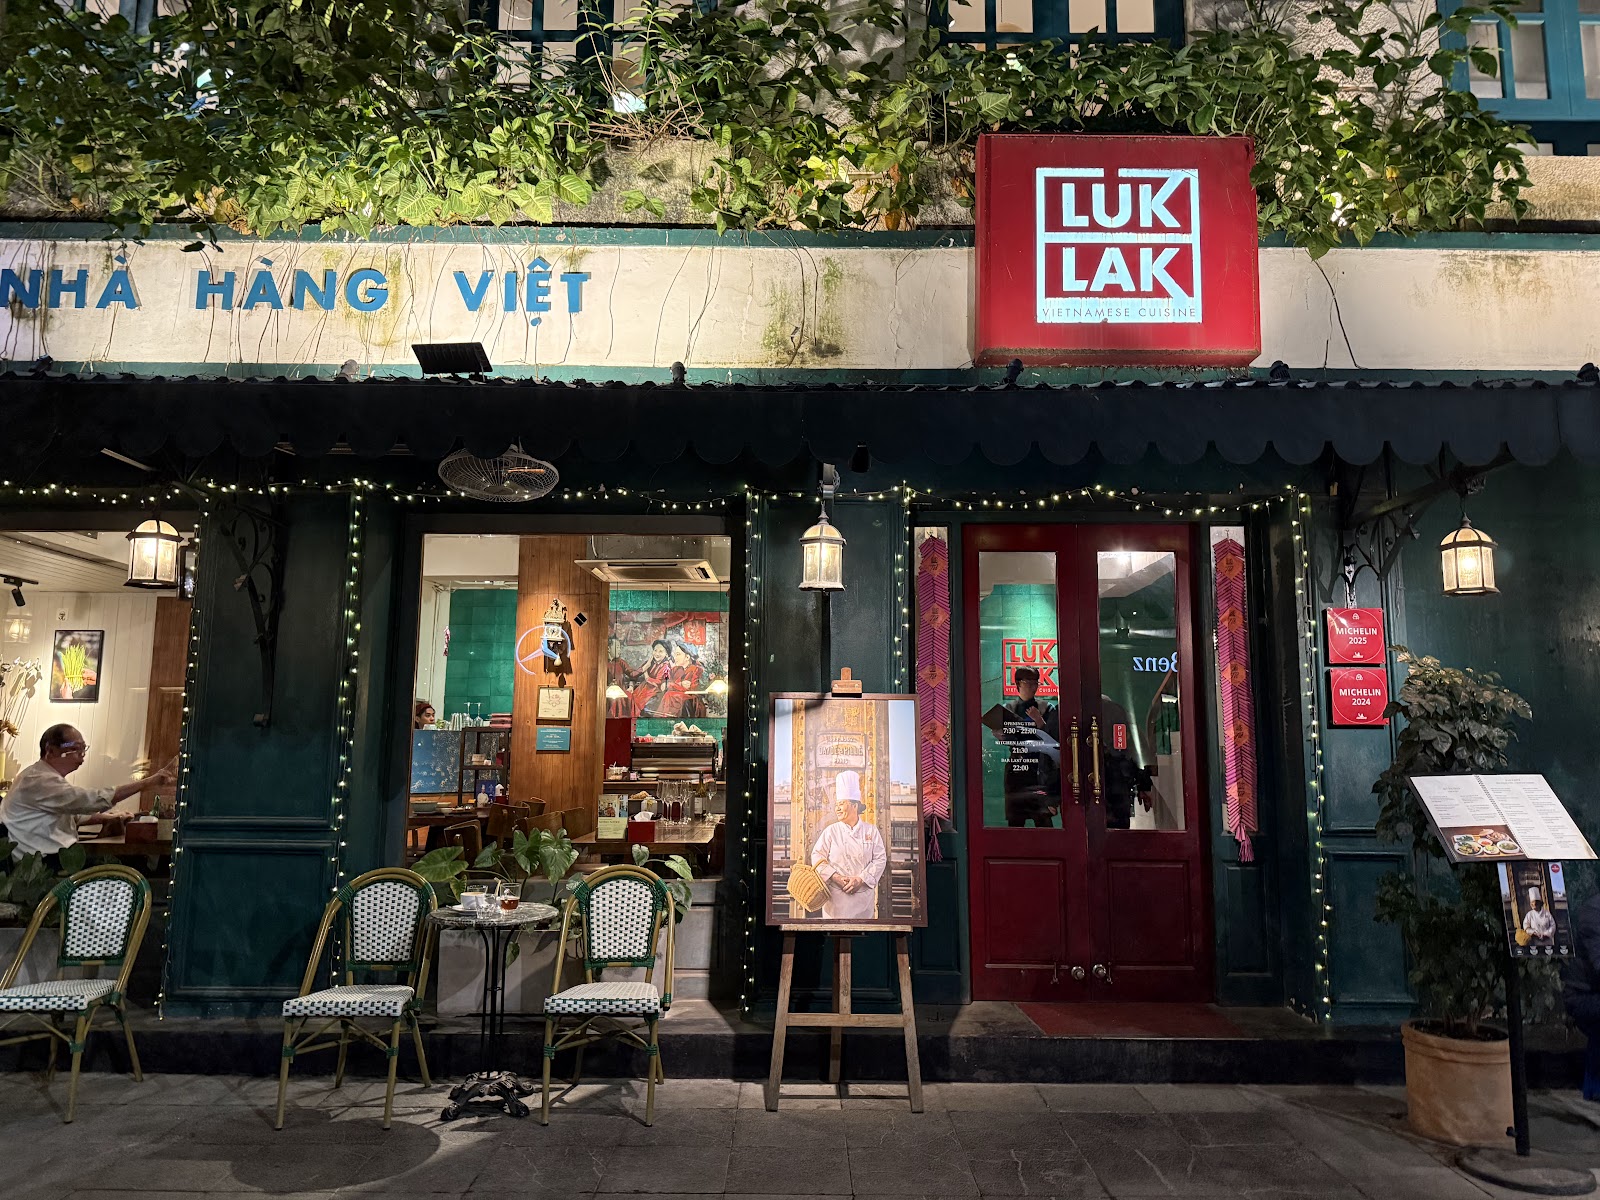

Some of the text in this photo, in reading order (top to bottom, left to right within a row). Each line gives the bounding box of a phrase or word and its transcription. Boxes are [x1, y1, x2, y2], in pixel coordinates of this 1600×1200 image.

[1062, 177, 1184, 228] LUK
[1062, 247, 1185, 295] LAK
[0, 255, 590, 326] NHÀ HÀNG VIỆT
[1042, 308, 1196, 318] VIETNAMESE CUISINE
[1336, 627, 1378, 635] MICHELIN
[1011, 643, 1054, 661] LUK
